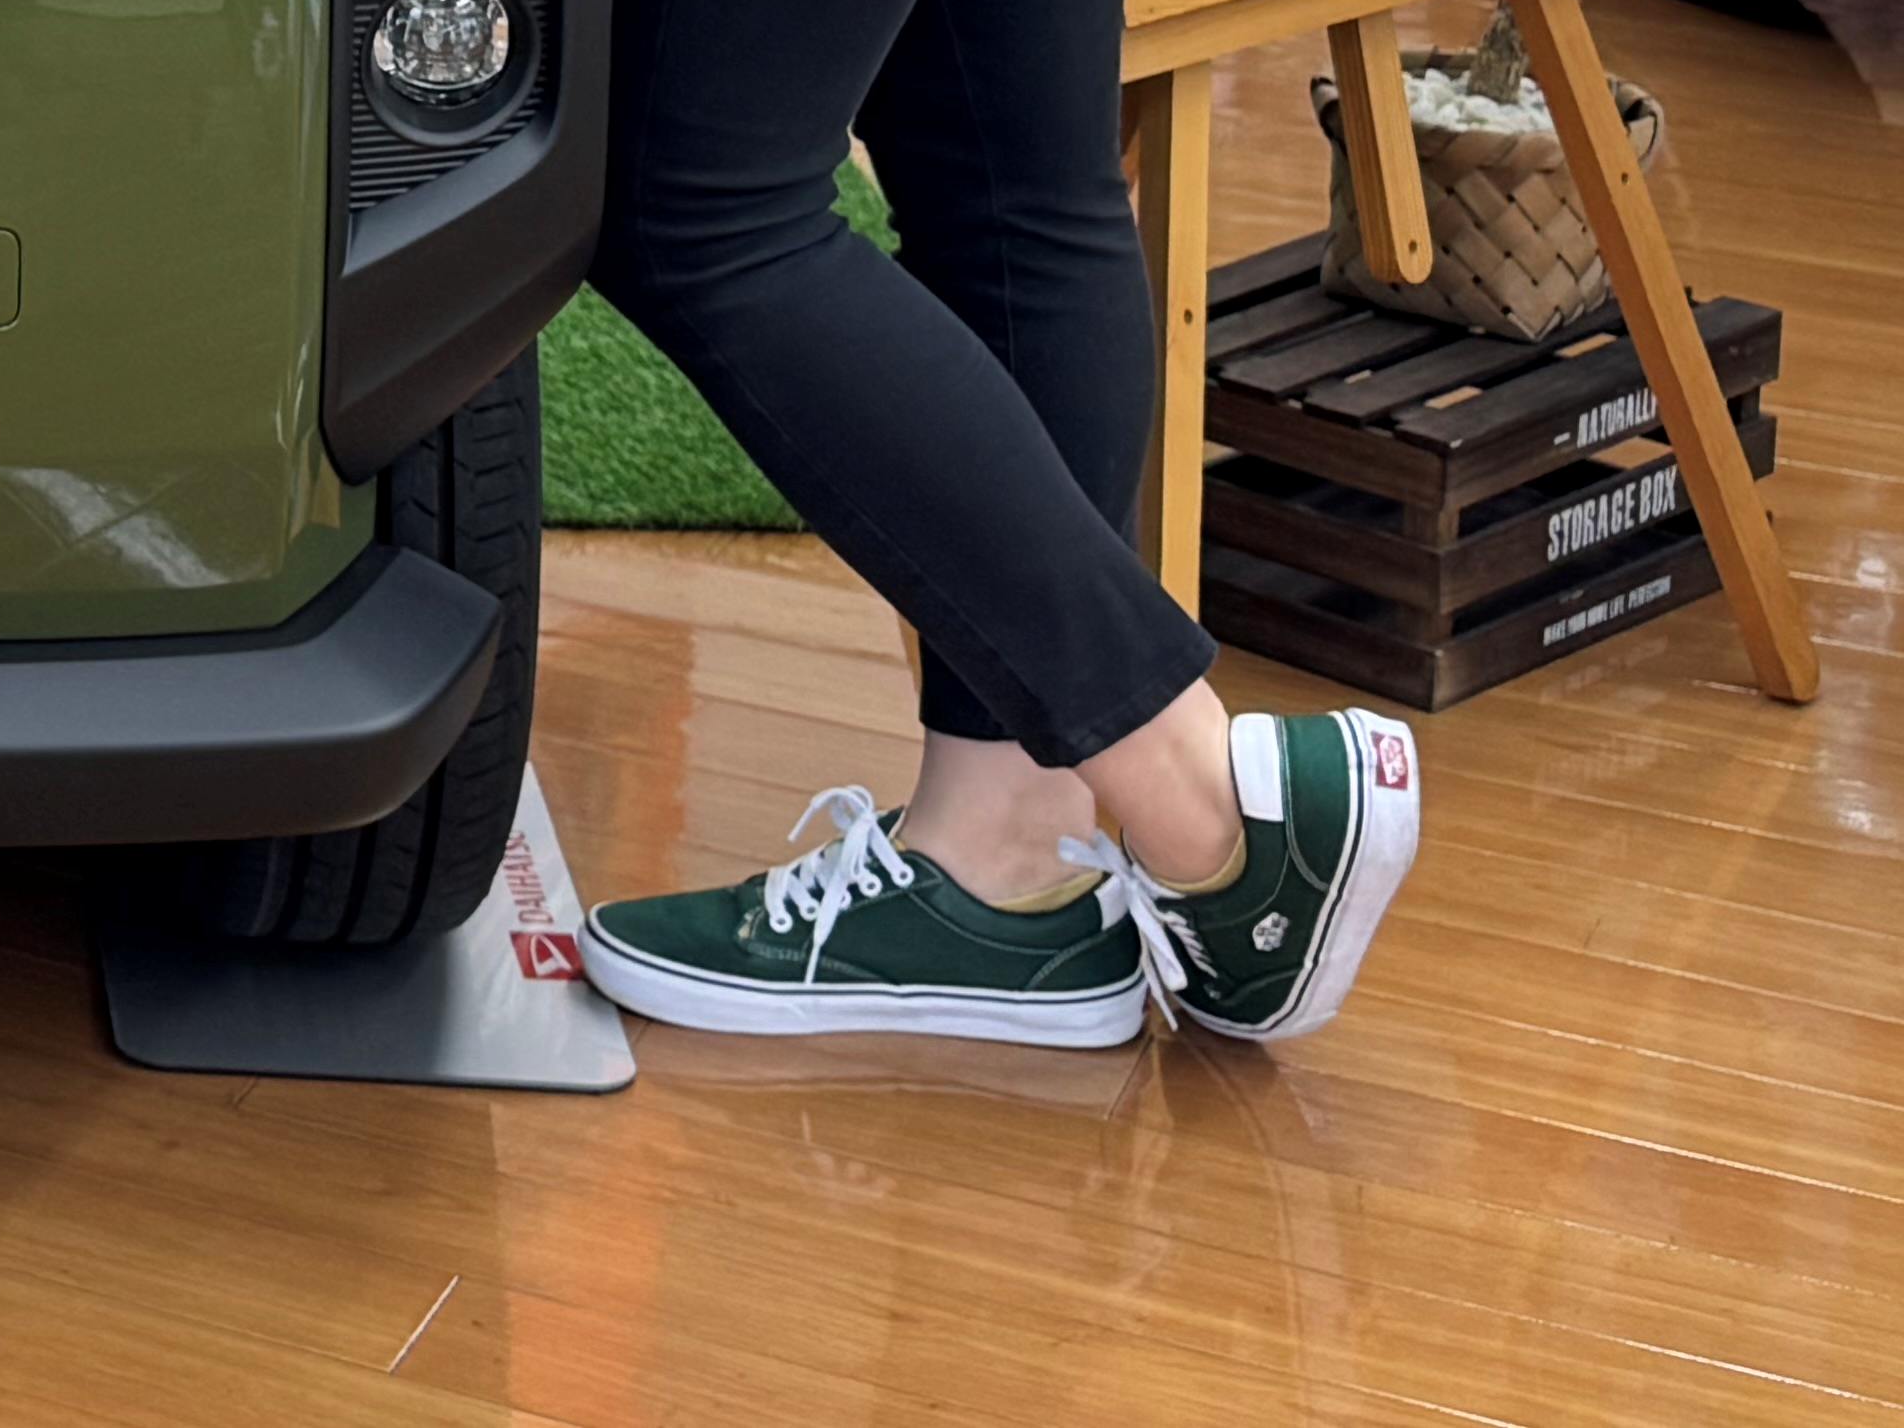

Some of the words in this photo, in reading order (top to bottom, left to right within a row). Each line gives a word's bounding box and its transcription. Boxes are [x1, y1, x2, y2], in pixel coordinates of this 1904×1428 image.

[1547, 483, 1637, 562] STORAGE
[1639, 464, 1679, 524] BOX
[503, 831, 554, 925] DAIHATS
